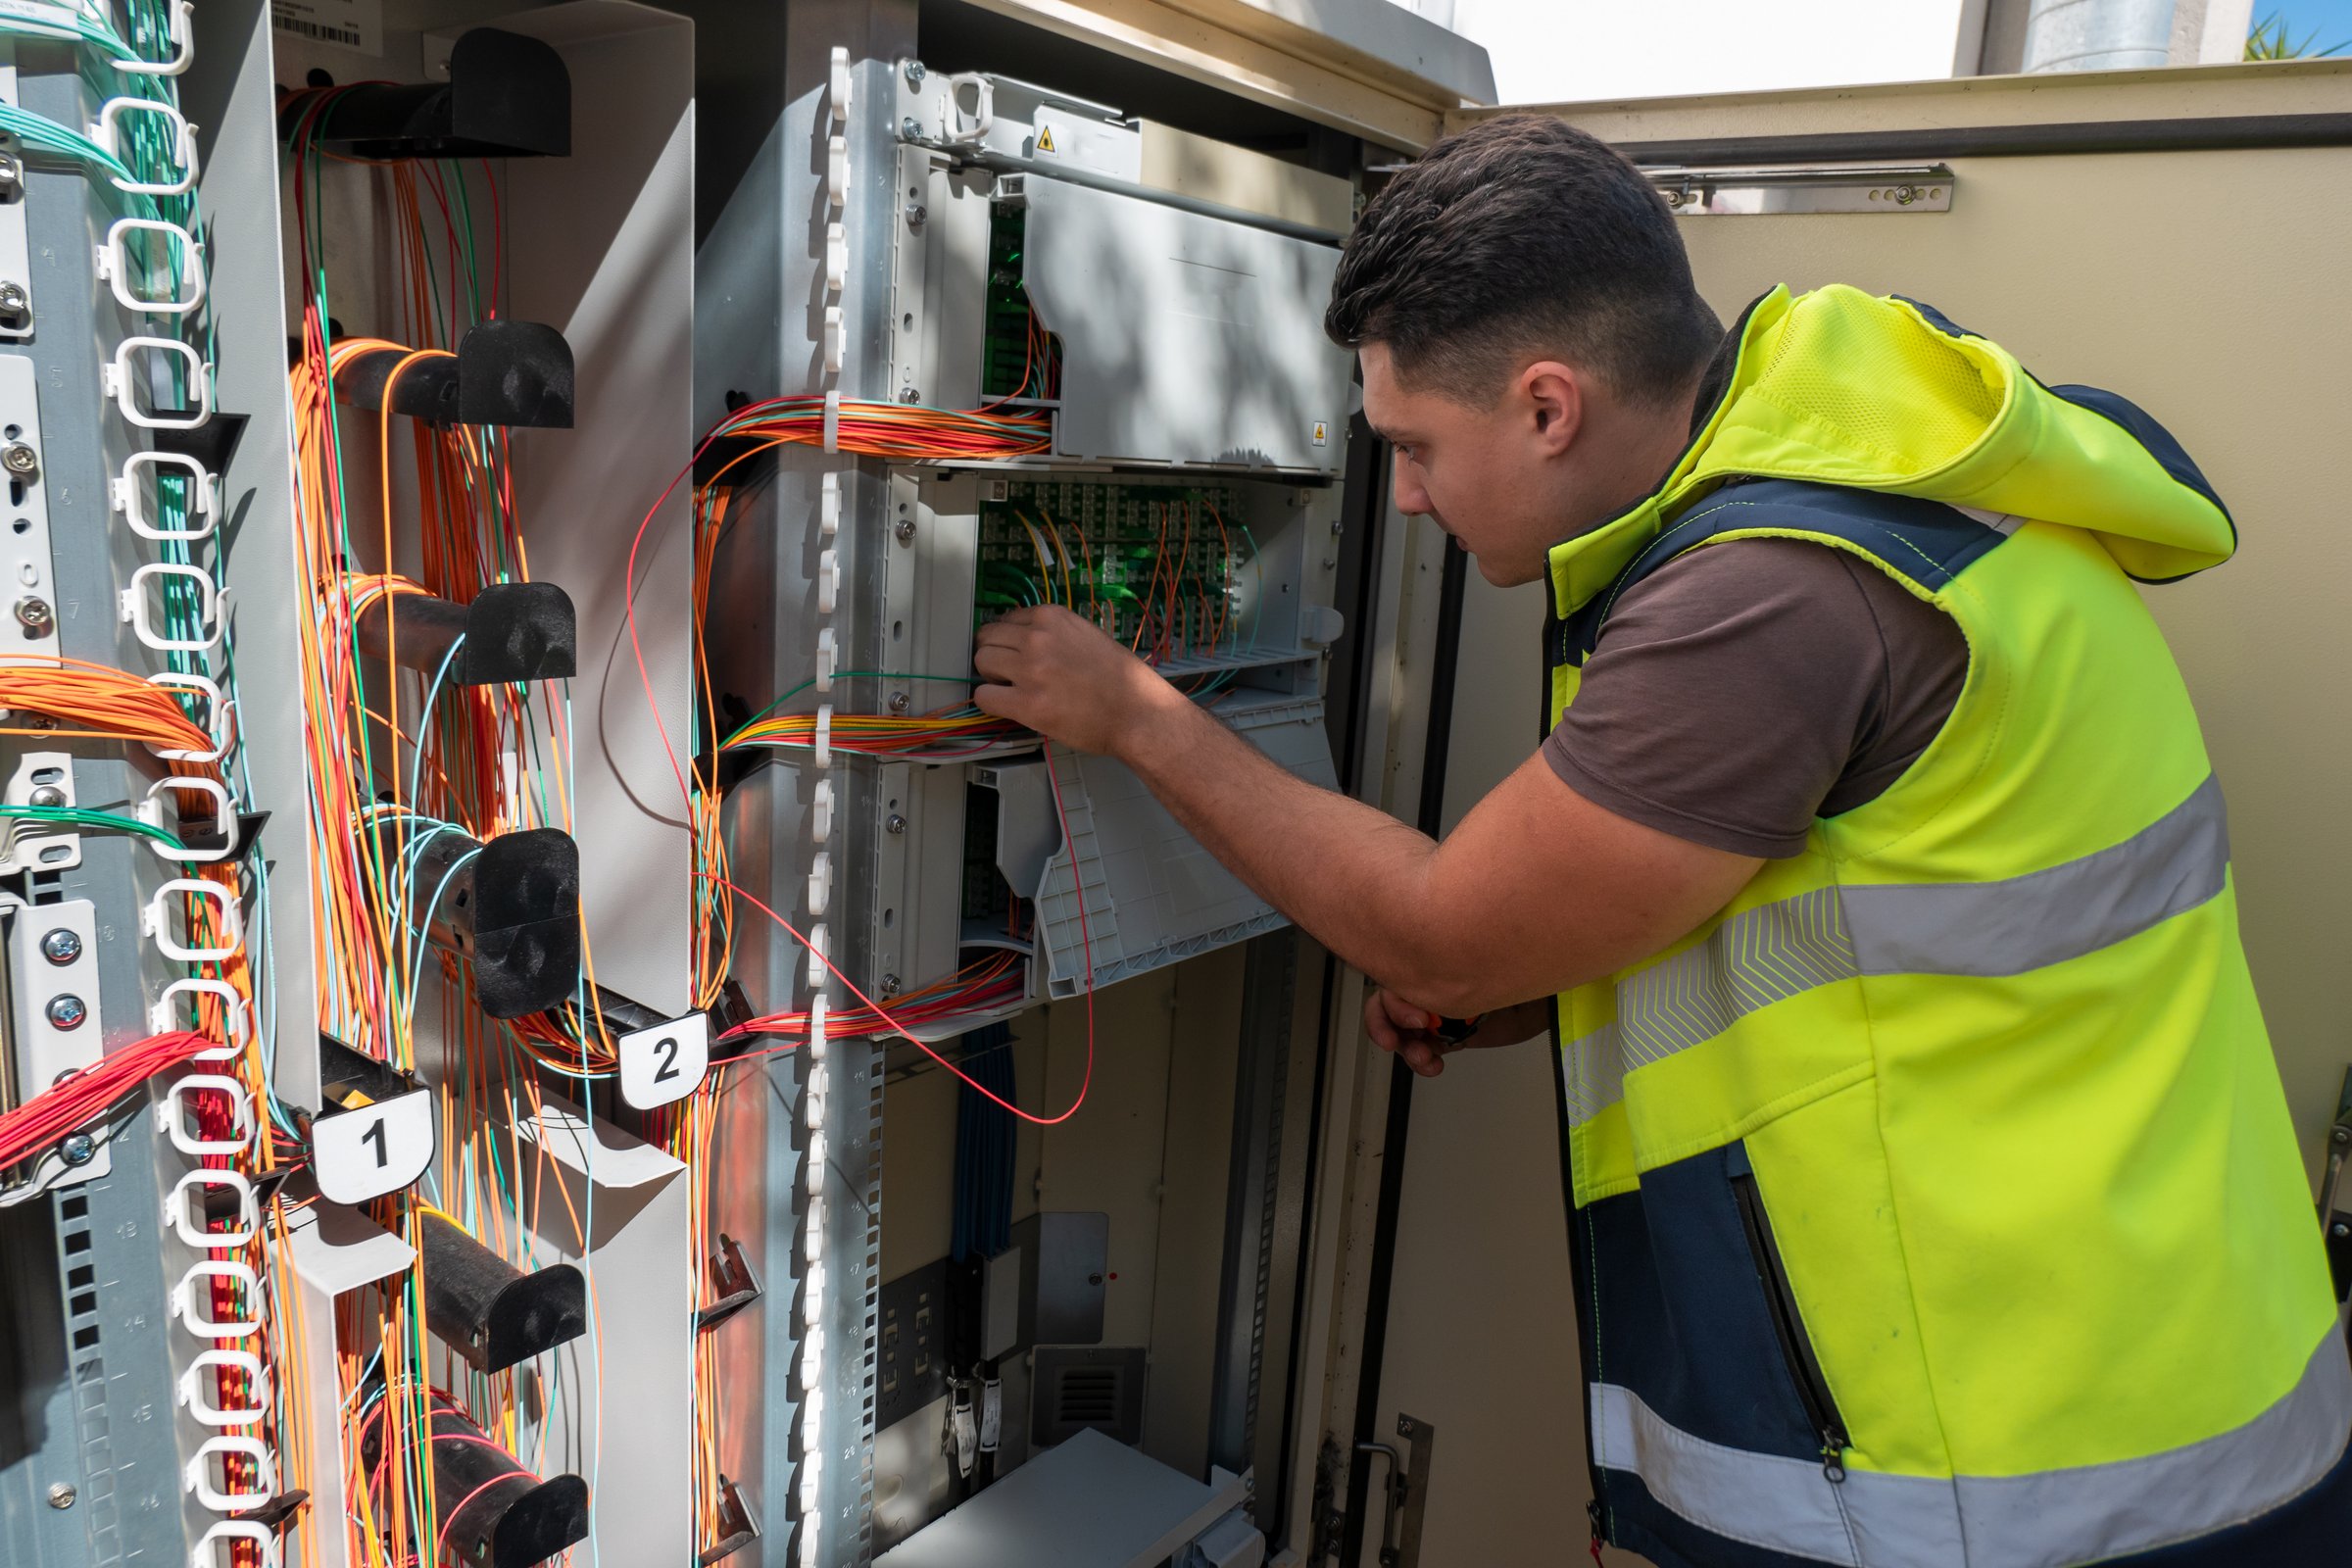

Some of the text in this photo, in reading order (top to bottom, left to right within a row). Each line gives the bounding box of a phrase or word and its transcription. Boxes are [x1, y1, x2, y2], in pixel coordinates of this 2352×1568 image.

[68, 599, 80, 619] 7
[653, 1037, 680, 1084] 2
[362, 1117, 388, 1169] 1
